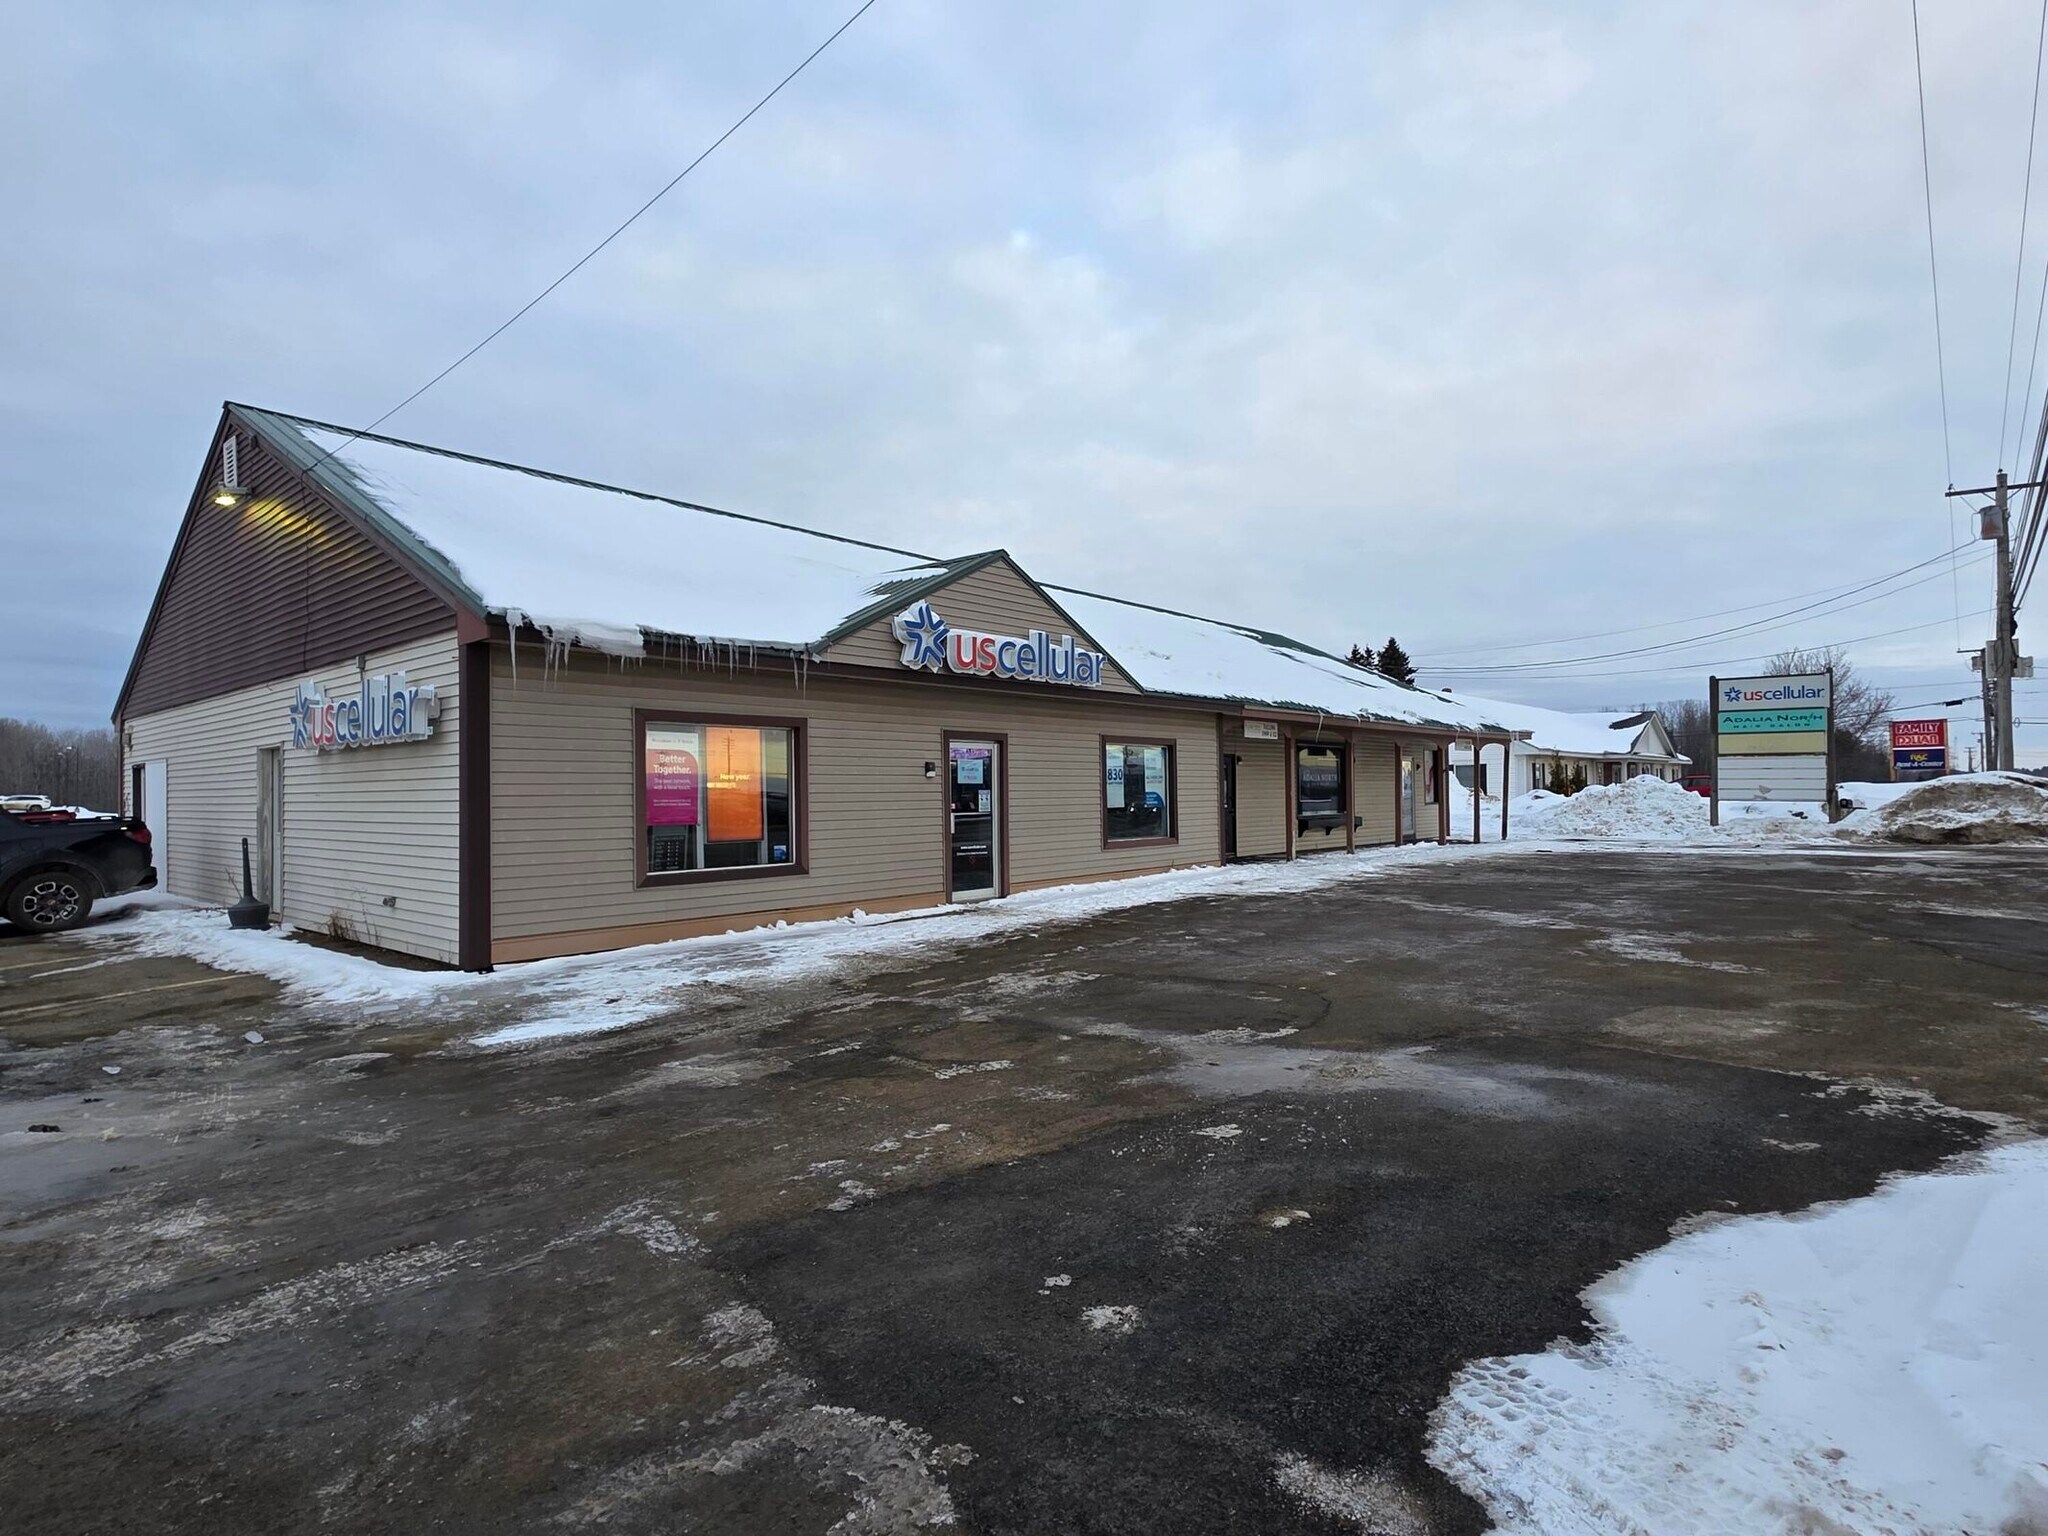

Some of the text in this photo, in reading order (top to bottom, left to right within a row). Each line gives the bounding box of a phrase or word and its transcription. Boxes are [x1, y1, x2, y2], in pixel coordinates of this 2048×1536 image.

[957, 632, 1107, 683] uscellular
[1743, 685, 1825, 701] uscellular
[310, 674, 419, 745] uscellular
[1722, 716, 1773, 724] ADALIA
[1895, 722, 1940, 735] FAMILY
[1895, 733, 1940, 746] DOLLAR
[659, 754, 686, 763] Better
[653, 764, 692, 775] Together.
[1107, 768, 1123, 781] 830
